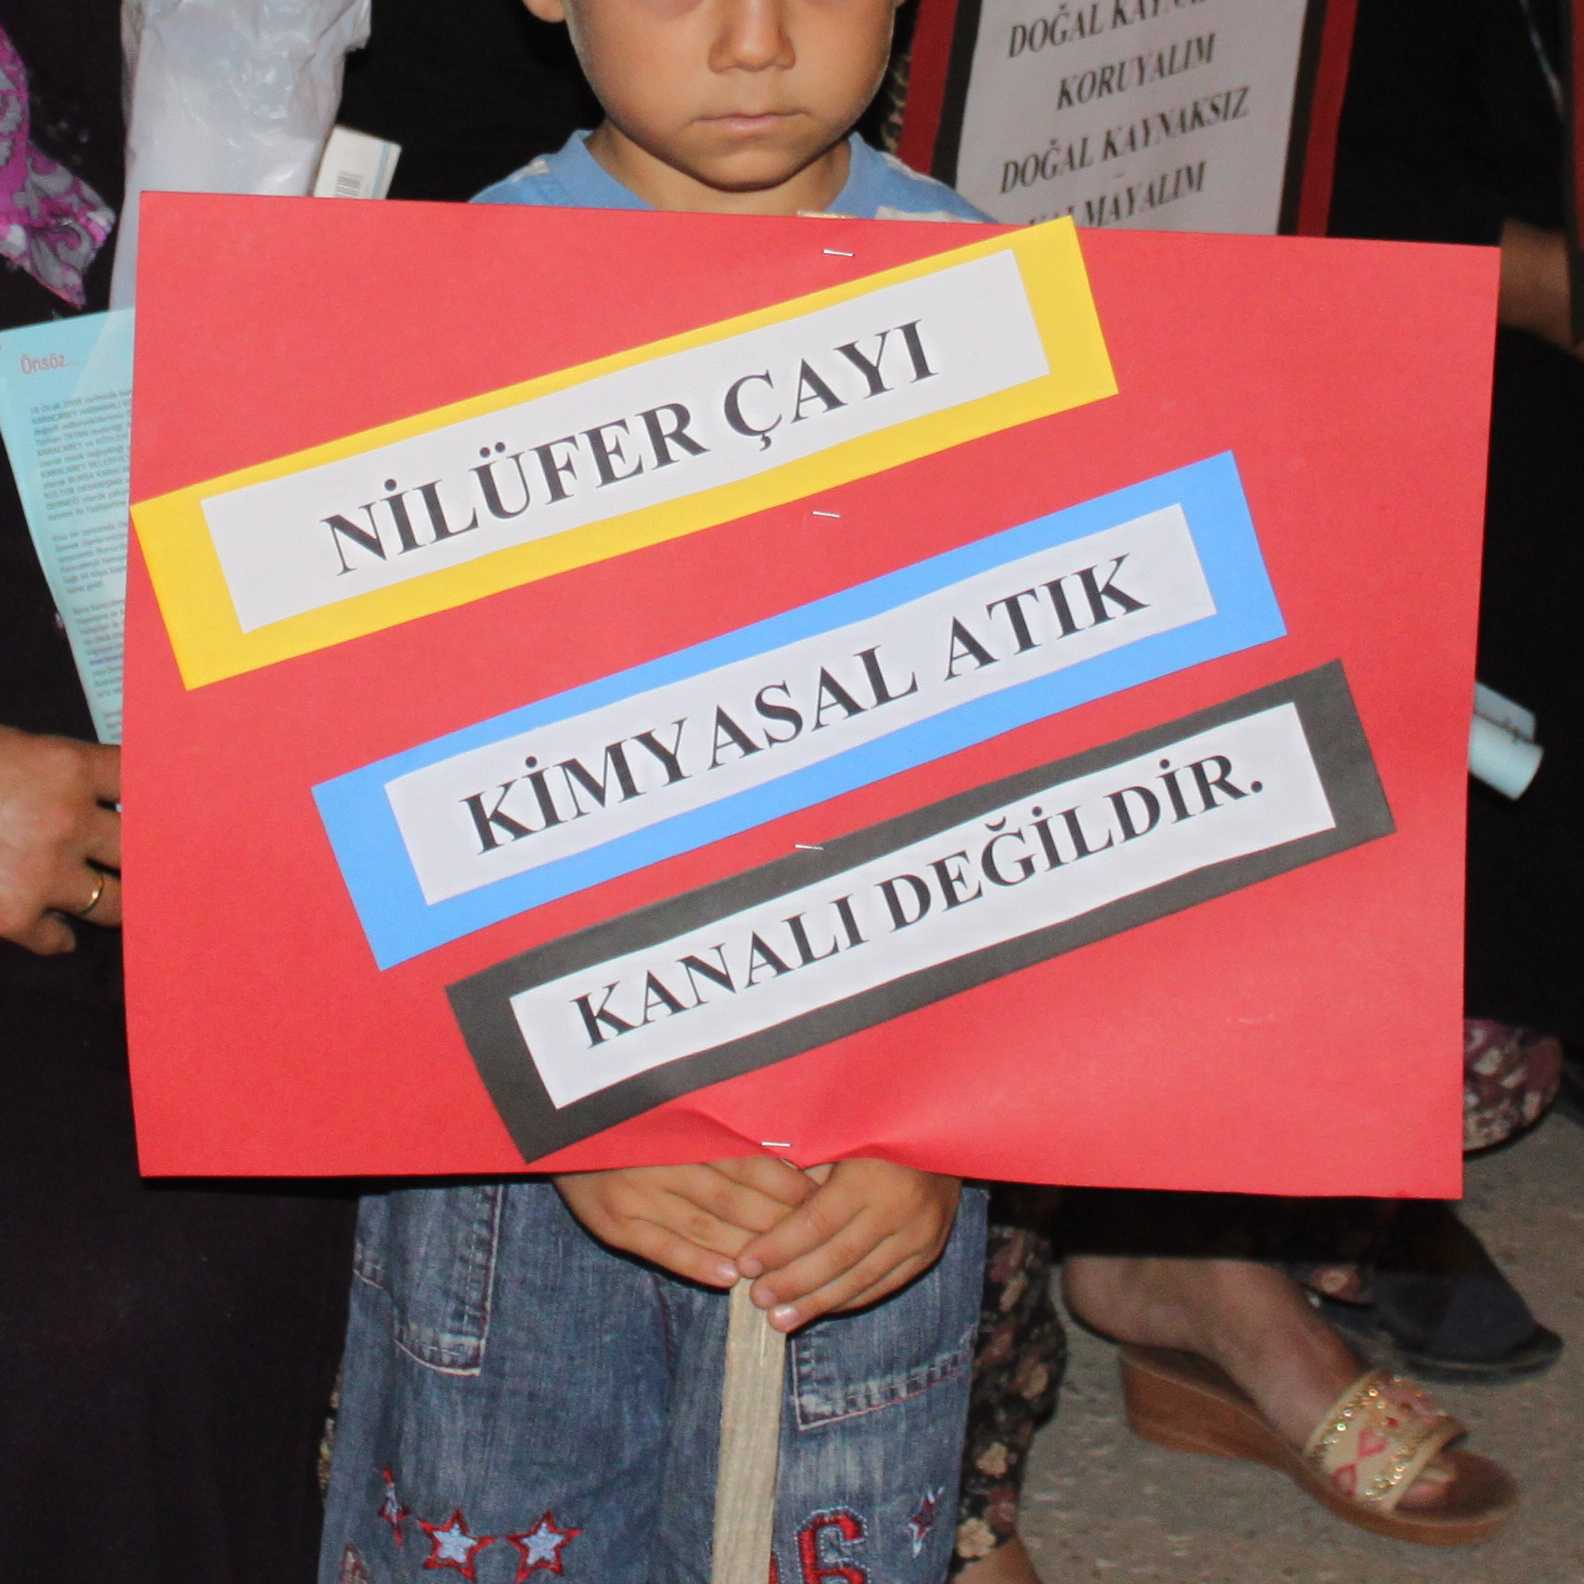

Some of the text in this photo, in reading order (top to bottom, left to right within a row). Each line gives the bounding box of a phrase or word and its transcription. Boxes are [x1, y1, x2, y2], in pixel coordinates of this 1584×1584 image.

[1008, 0, 1106, 59] DOĞAL
[1055, 31, 1216, 111] KORUYALIM
[999, 85, 1250, 194] DOĞAL KAYNAKSIZ
[1026, 160, 1208, 228] MAYALIM
[320, 319, 939, 576] NİLÜFER ÇAYI
[458, 553, 1151, 854] KİMYASAL ATIK
[569, 752, 1263, 1048] KANALI DEĞİLDİR.
